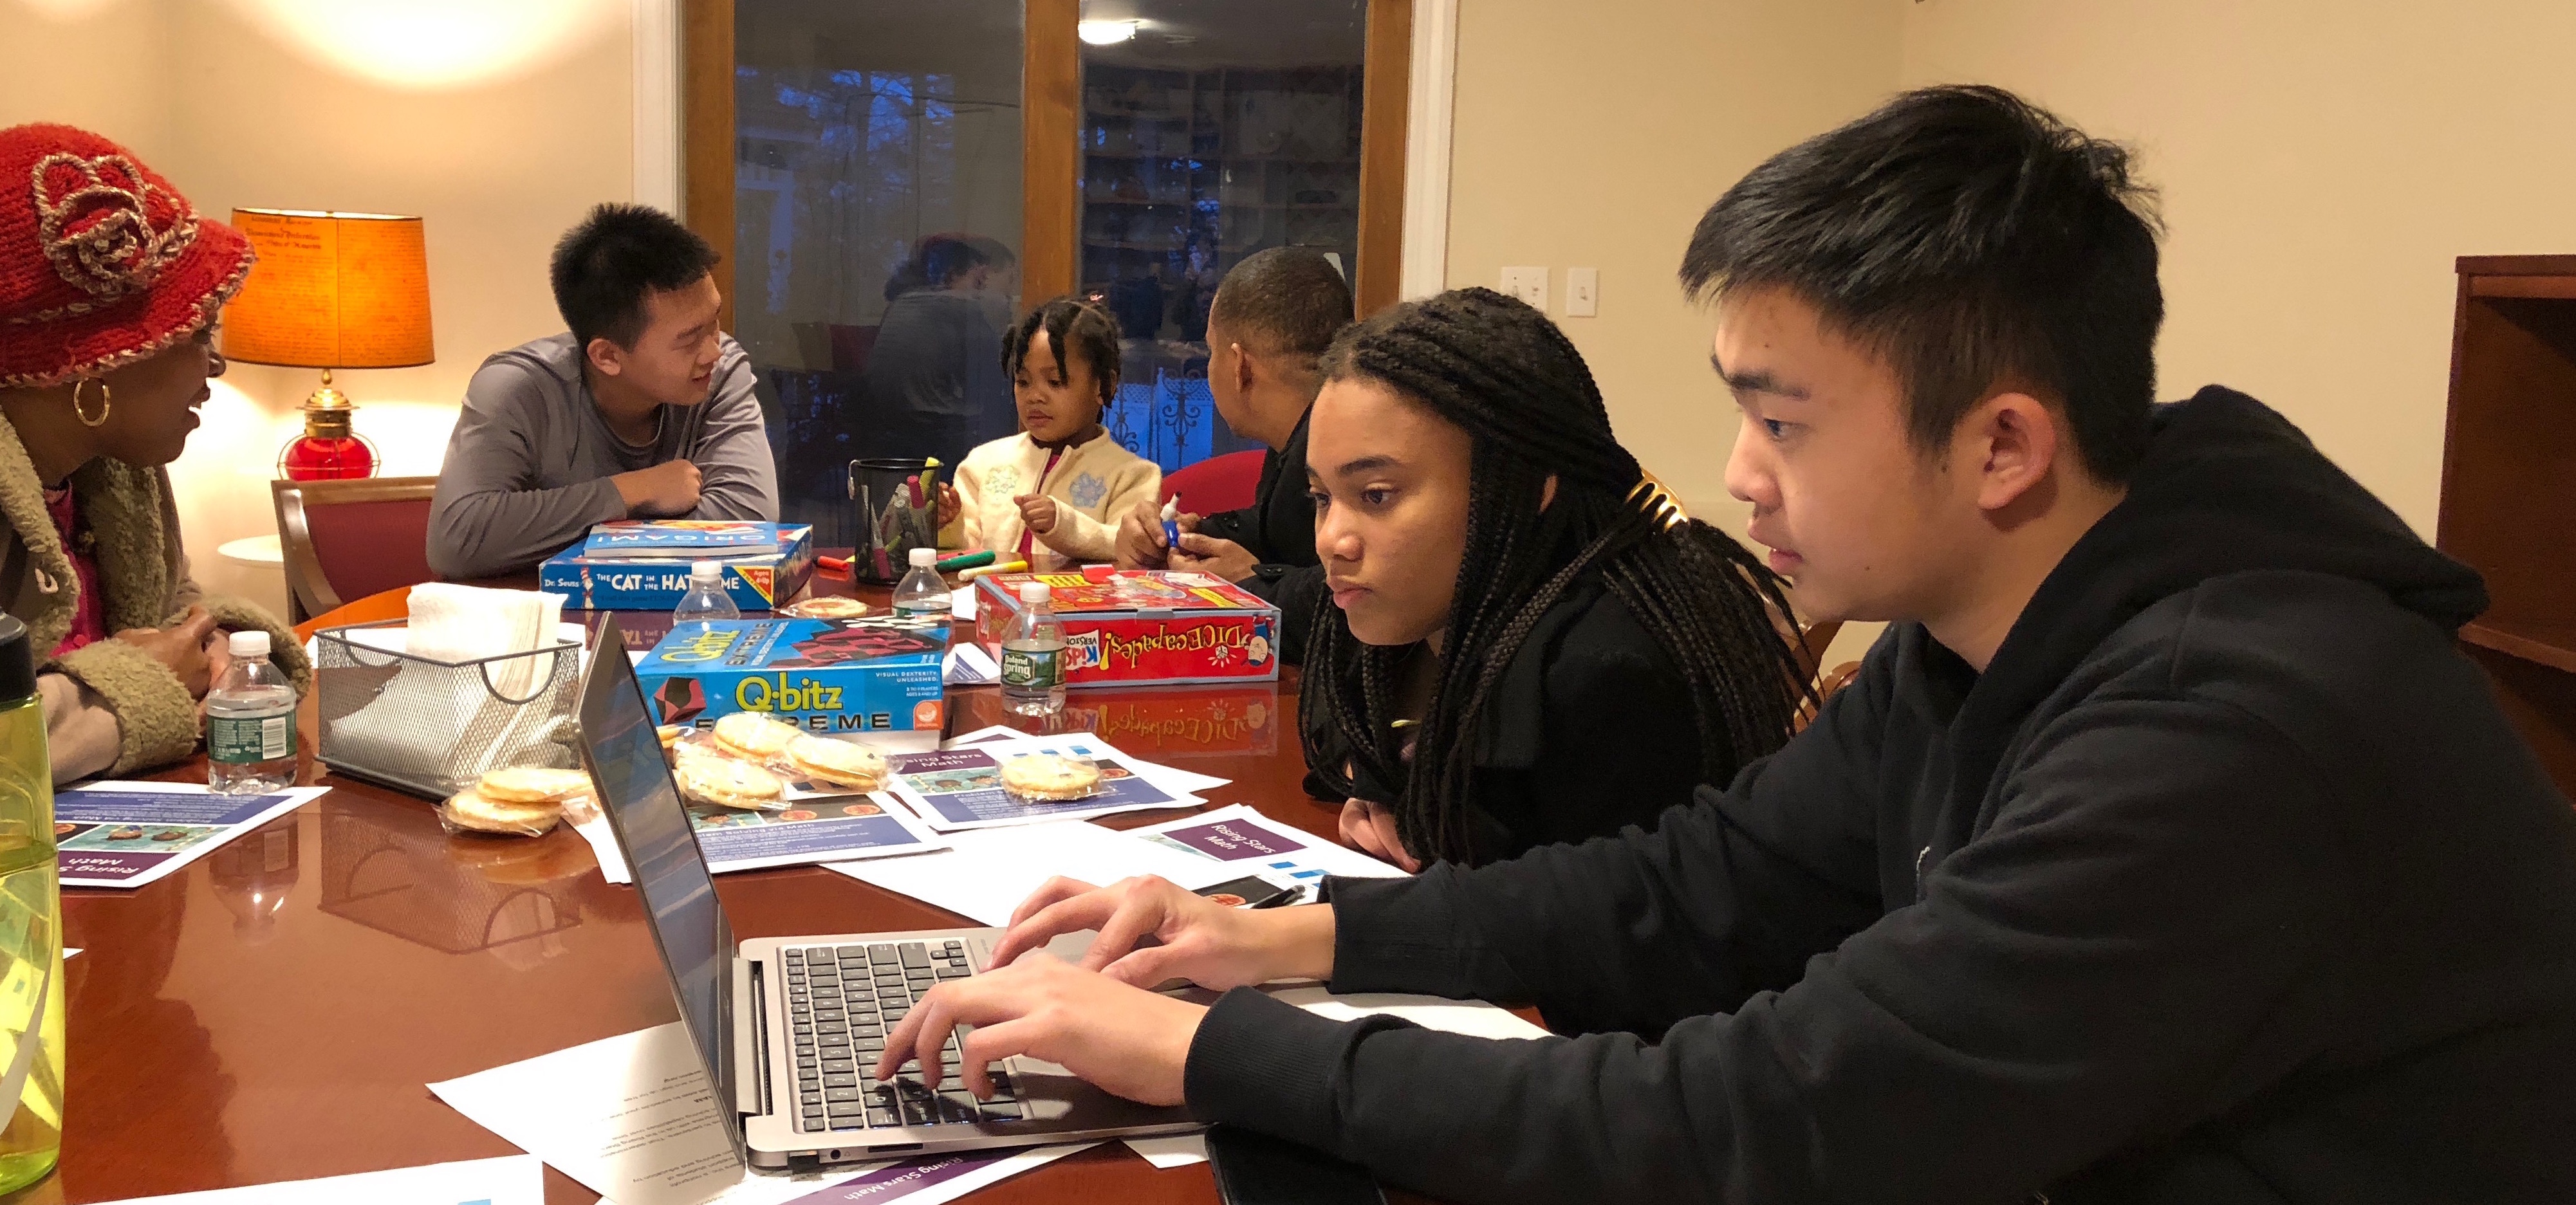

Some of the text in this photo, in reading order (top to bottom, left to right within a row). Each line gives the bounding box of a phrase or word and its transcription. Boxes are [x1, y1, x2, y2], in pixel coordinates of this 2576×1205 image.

[598, 534, 766, 543] ORIGAMI
[558, 578, 579, 587] Seuss
[611, 573, 642, 591] CAT
[662, 574, 739, 591] HAT ME
[1005, 654, 1028, 666] Poland
[1065, 646, 1098, 667] Kids
[1003, 663, 1032, 679] Spring
[695, 713, 891, 731] EREME
[1204, 836, 1238, 850] Math
[1210, 824, 1277, 854] Rising Stars
[75, 865, 140, 874] Rising
[844, 1157, 964, 1200] Rising Stars Math
